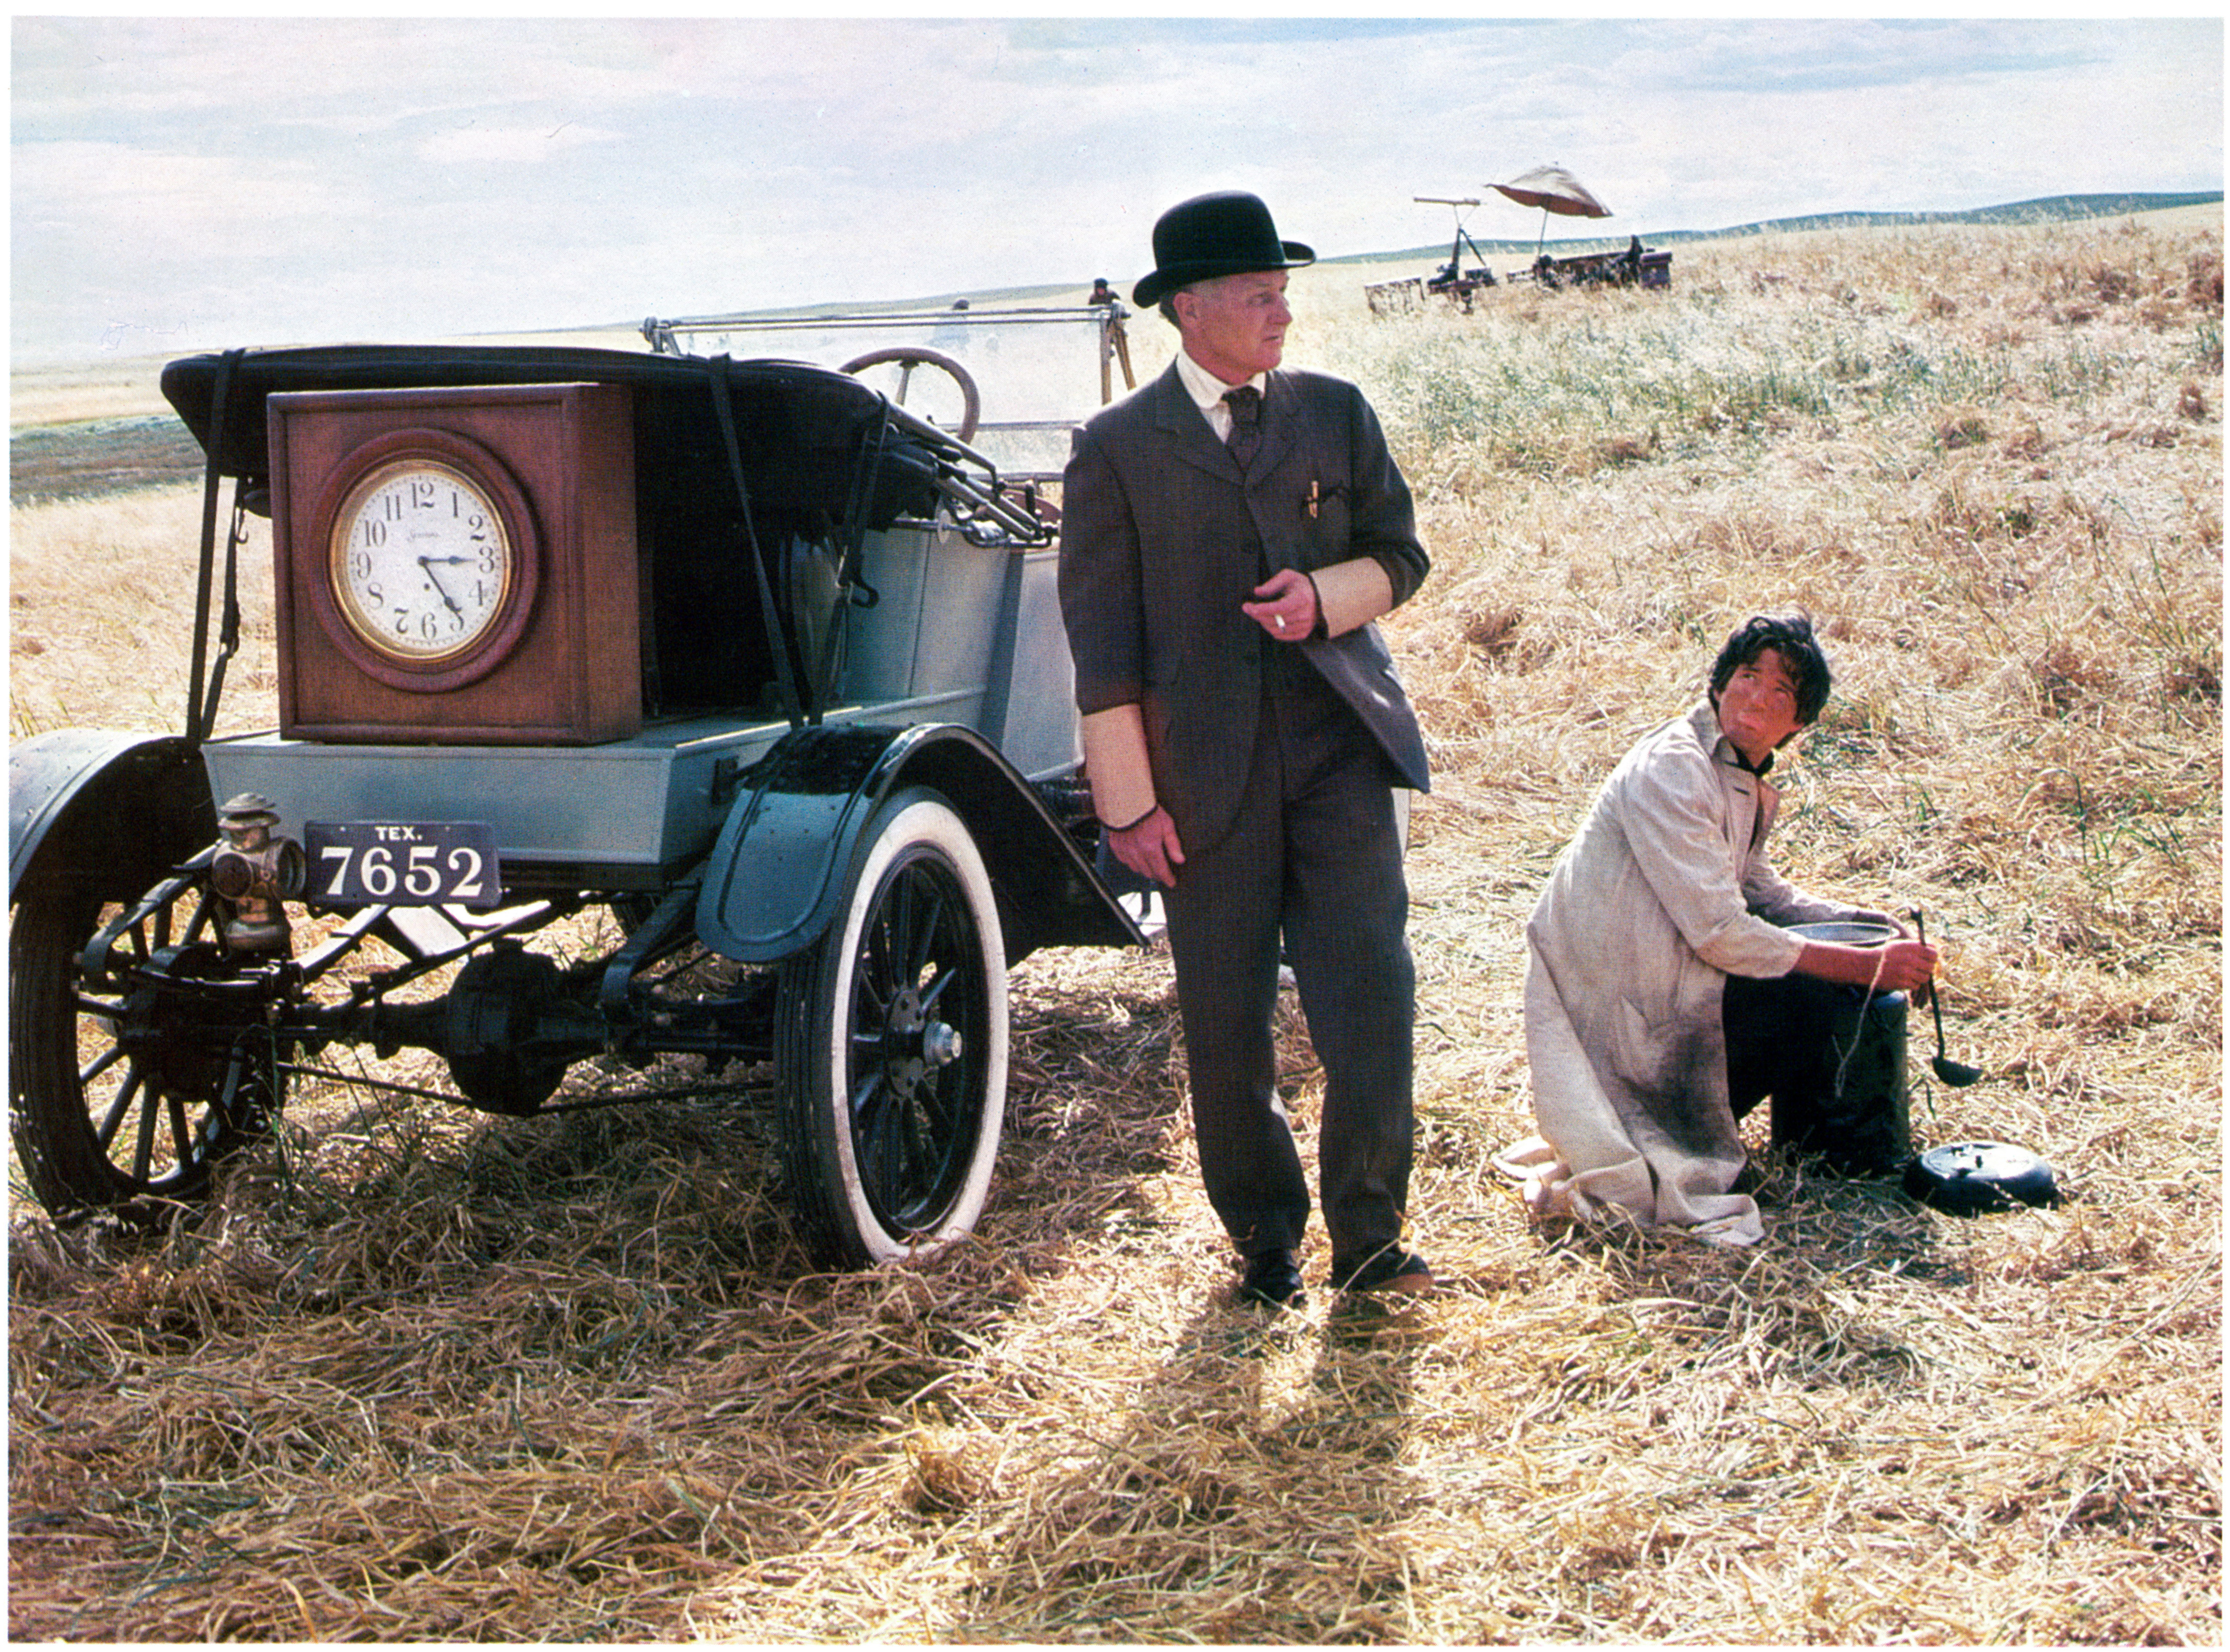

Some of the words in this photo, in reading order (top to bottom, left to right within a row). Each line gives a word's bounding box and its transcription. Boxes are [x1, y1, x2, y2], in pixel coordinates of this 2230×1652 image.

[385, 494, 401, 521] 11
[410, 482, 434, 509] 12
[452, 491, 458, 518] 1
[365, 519, 386, 547] 10
[468, 514, 485, 541] 2
[356, 552, 371, 580] 9
[478, 545, 494, 574] 3
[367, 582, 384, 610] 8
[468, 580, 489, 607] 4
[394, 607, 409, 634] 7
[421, 612, 436, 639] 6
[374, 825, 423, 841] TEX.
[321, 845, 483, 897] 7652
